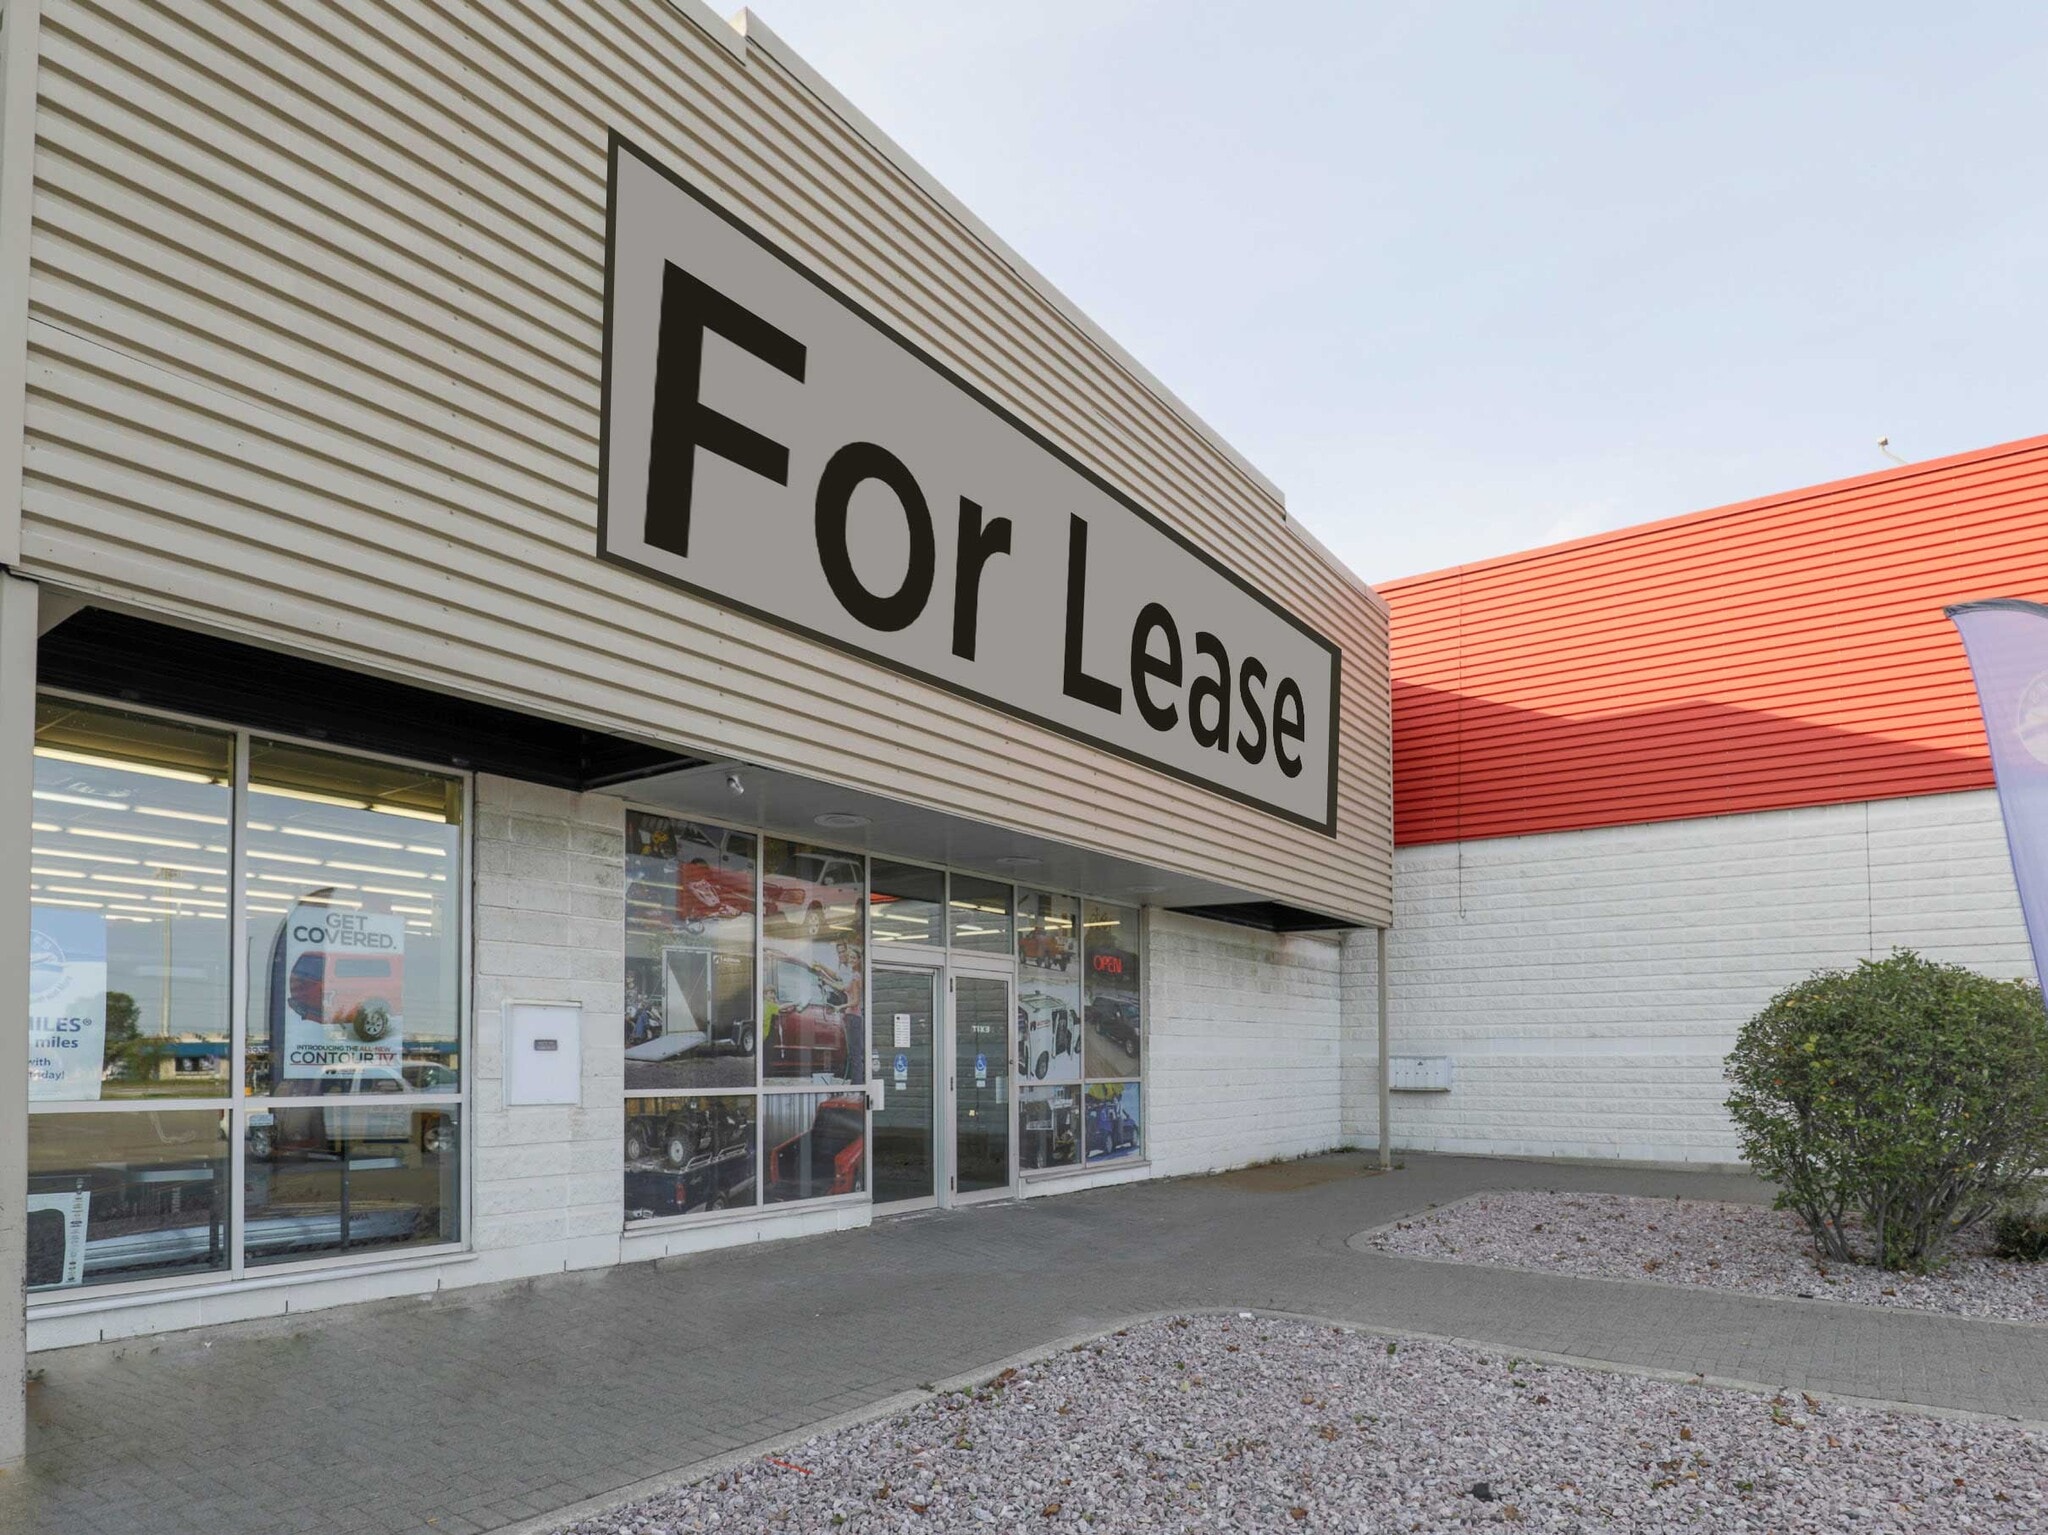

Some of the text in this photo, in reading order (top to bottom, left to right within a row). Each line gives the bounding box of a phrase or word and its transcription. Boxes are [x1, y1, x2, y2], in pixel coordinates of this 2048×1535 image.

[644, 259, 1304, 778] For Lease
[326, 912, 368, 931] GET
[293, 926, 397, 950] COVERED.
[1094, 955, 1122, 973] OPEN
[35, 1036, 79, 1048] miles
[290, 1051, 374, 1065] CONTOUR
